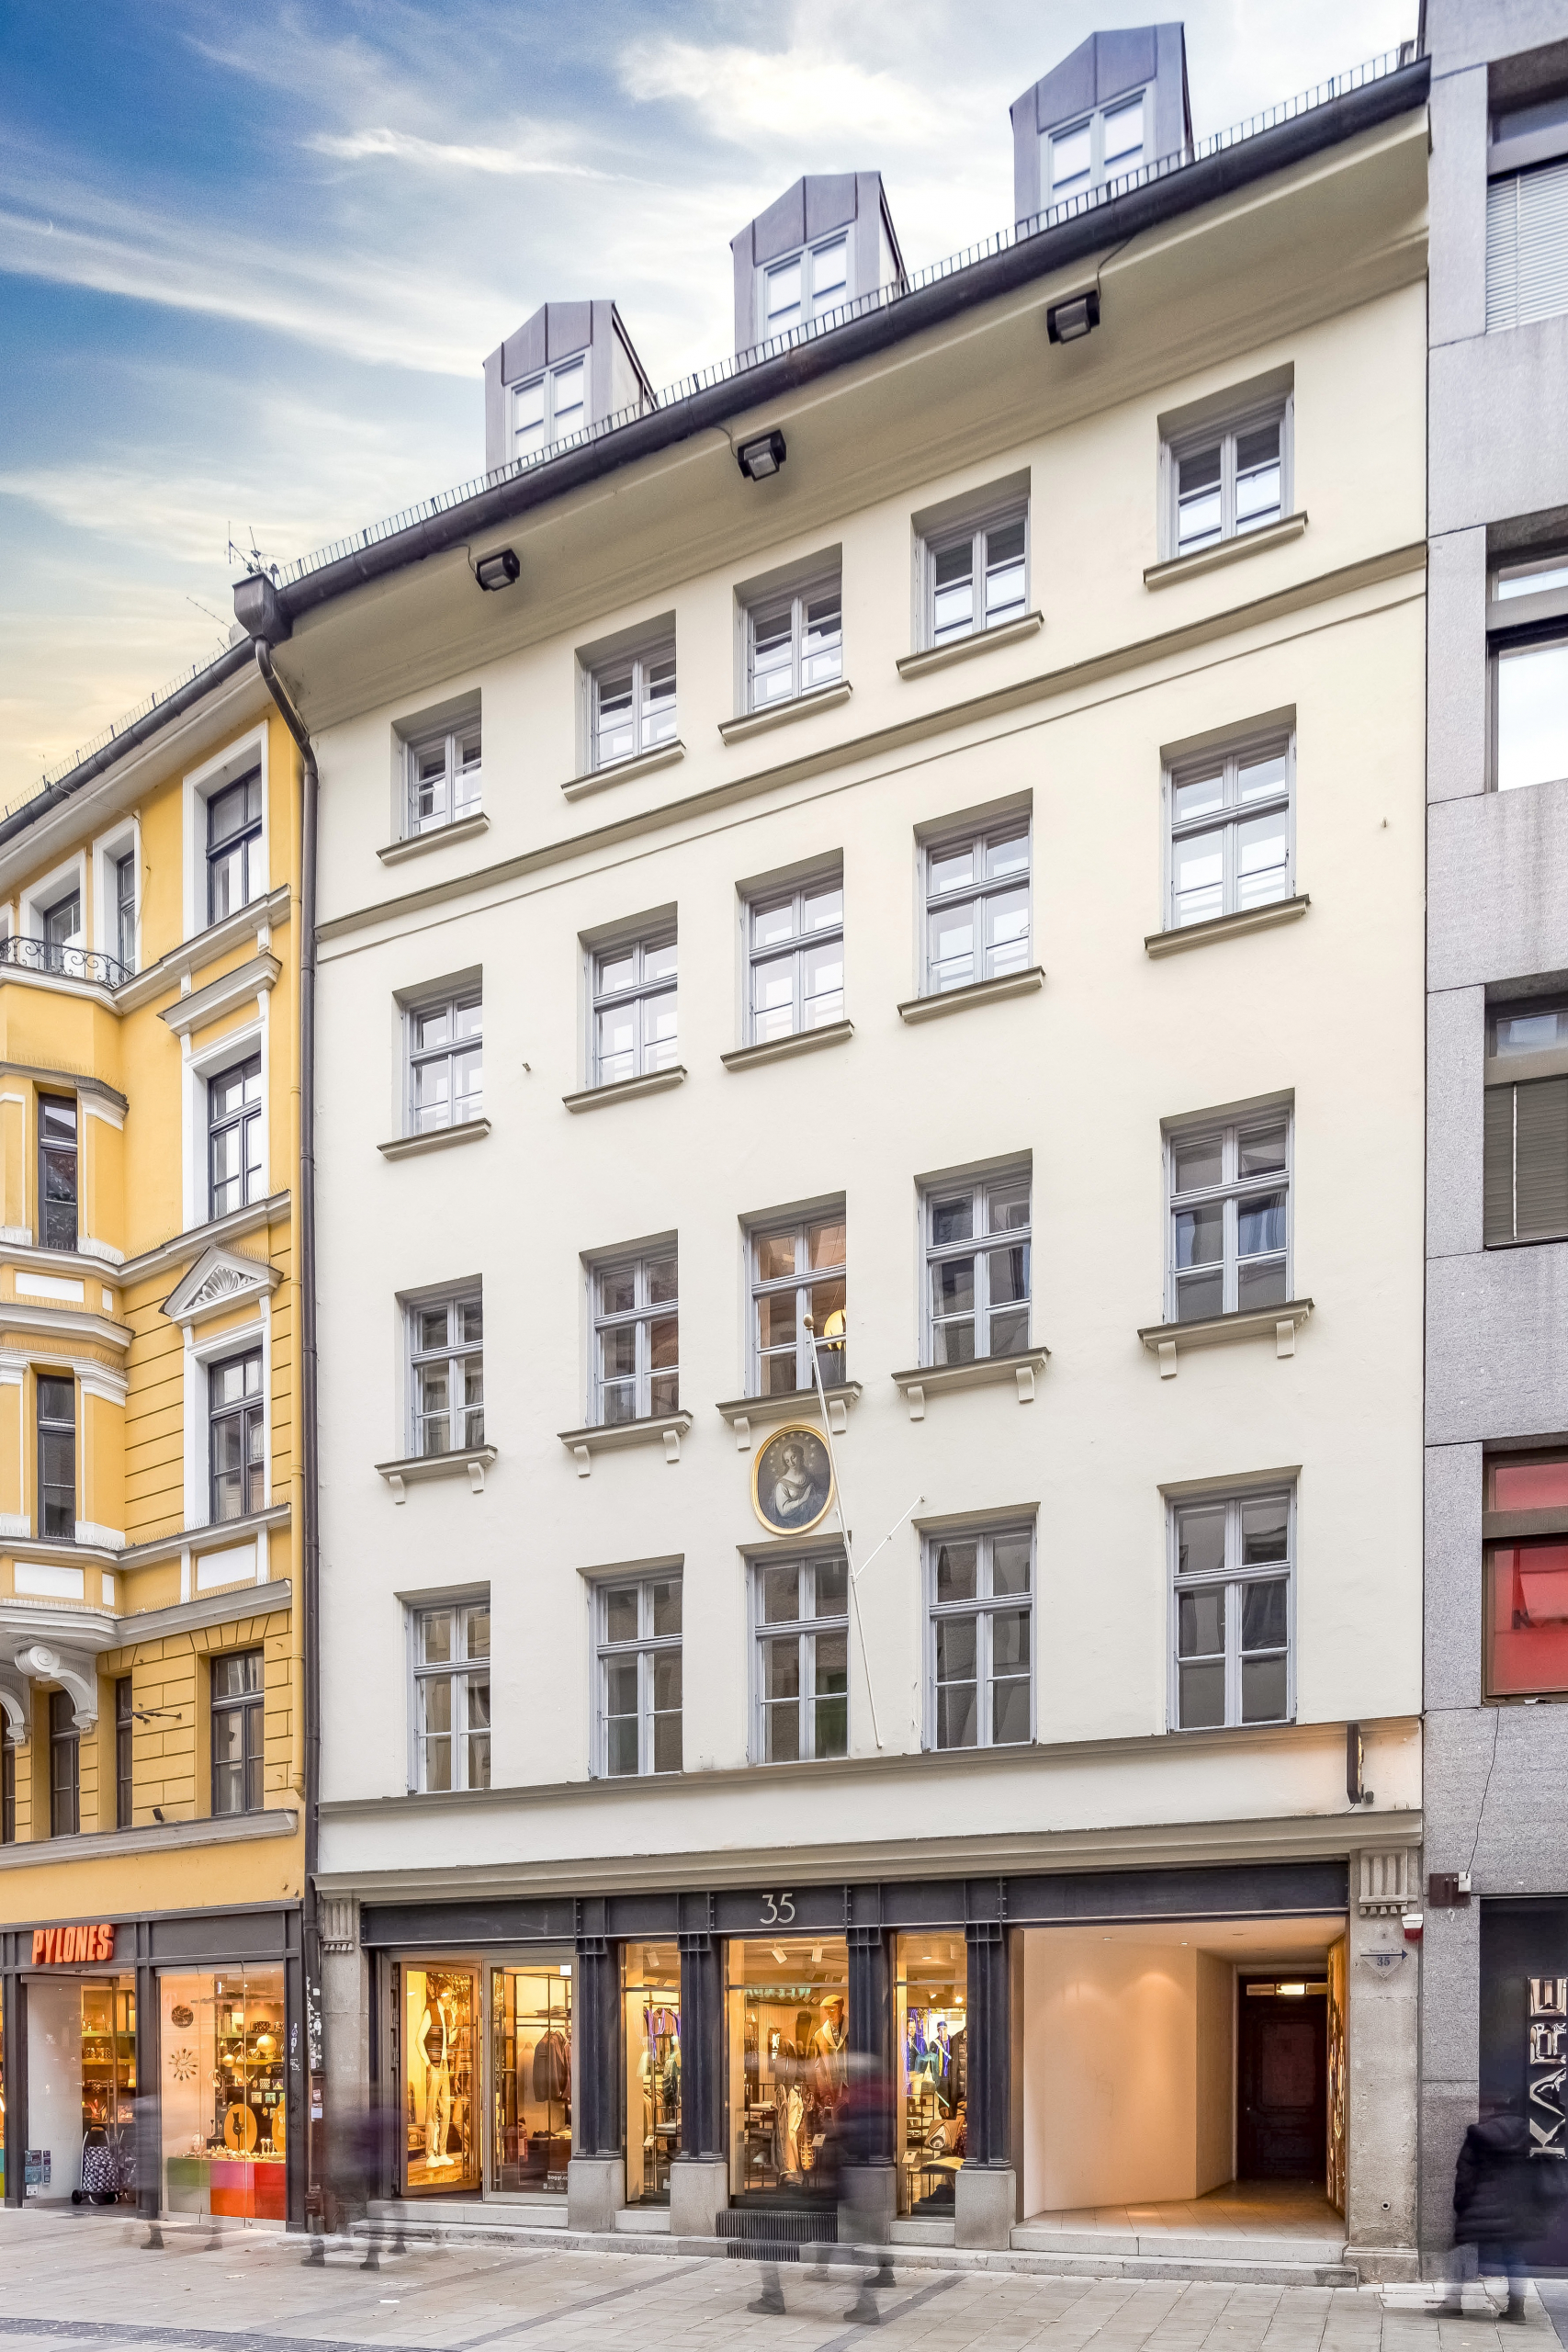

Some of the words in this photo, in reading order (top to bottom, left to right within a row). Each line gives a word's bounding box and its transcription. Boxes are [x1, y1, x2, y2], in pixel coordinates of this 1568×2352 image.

[760, 1894, 795, 1924] 35
[31, 1924, 114, 1964] PYLONES
[1377, 1957, 1390, 1966] 35
[1529, 1978, 1567, 2158] KARE
